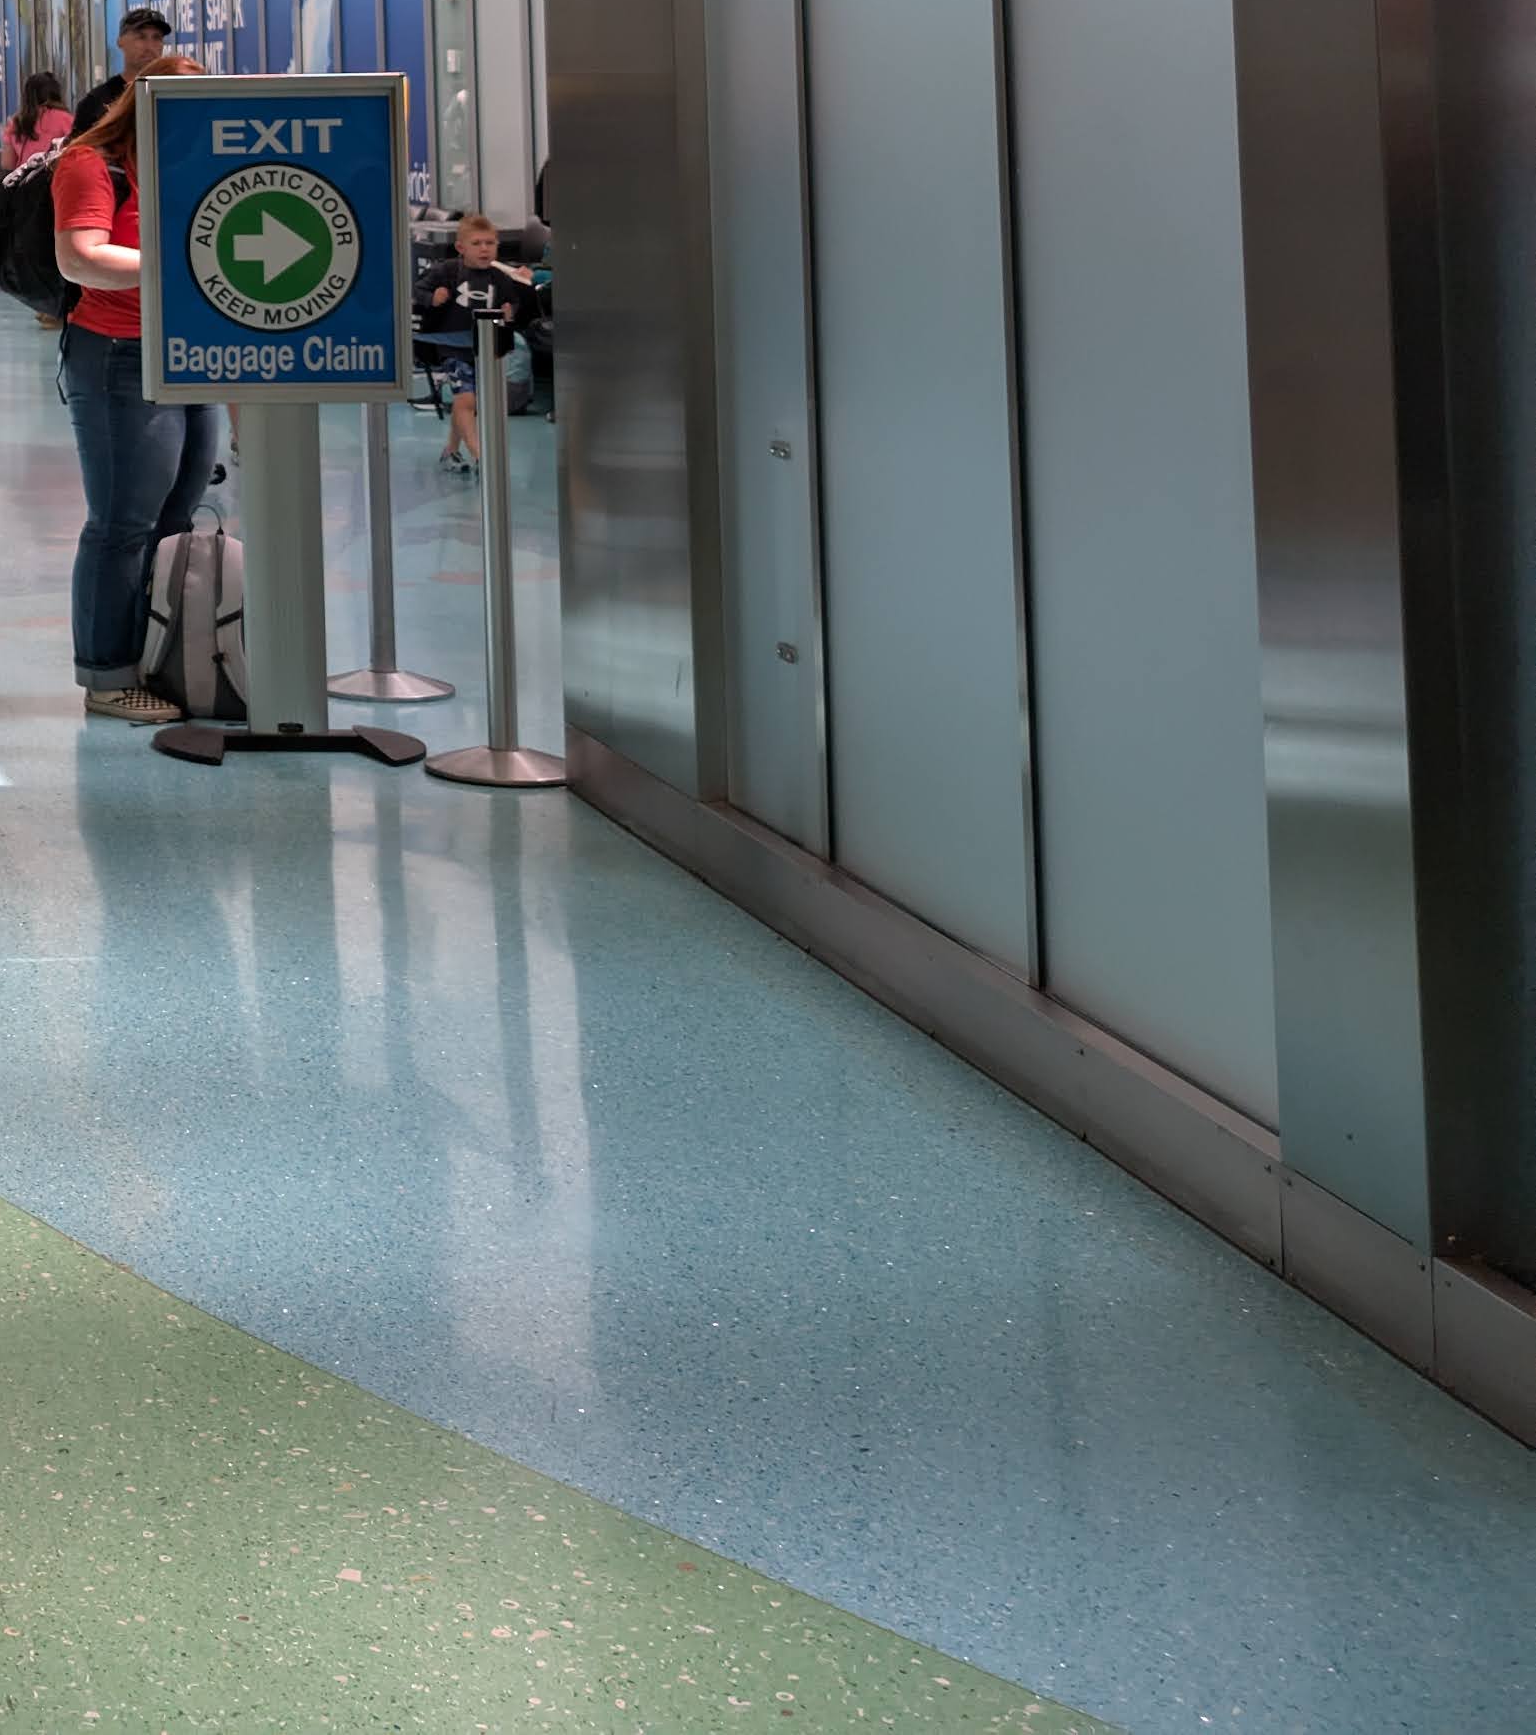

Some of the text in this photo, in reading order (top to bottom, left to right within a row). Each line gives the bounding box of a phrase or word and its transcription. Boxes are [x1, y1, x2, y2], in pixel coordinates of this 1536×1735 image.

[211, 118, 344, 154] EXIT
[194, 170, 353, 249] AUTOMATIC DOOR
[204, 273, 347, 325] KEEP MOVING
[167, 336, 385, 380] Baggage Claim
